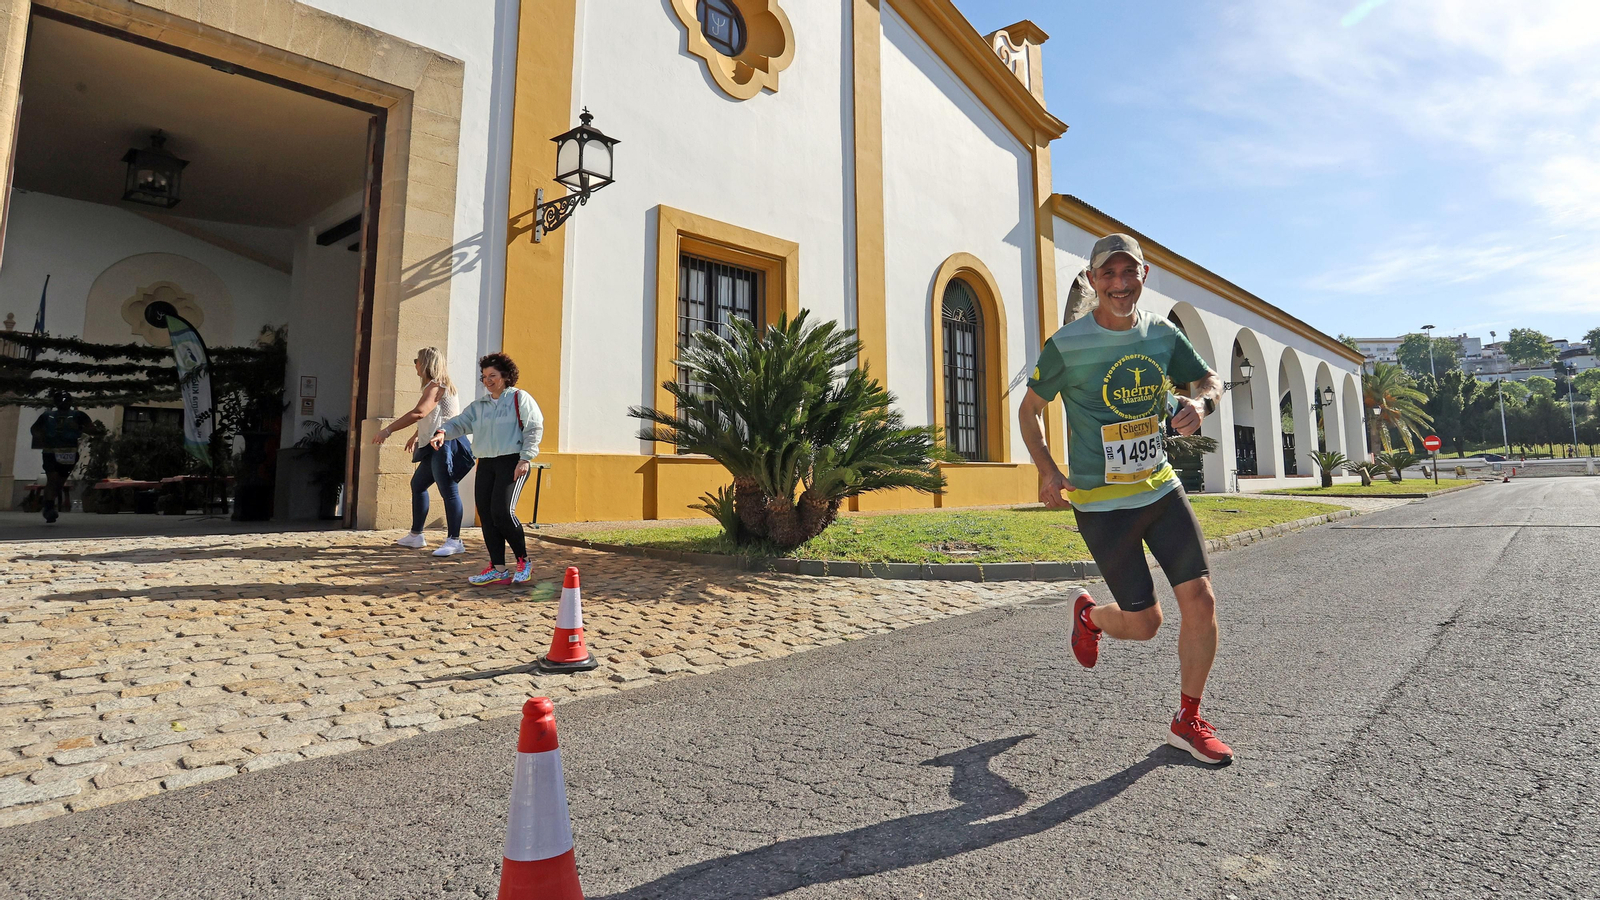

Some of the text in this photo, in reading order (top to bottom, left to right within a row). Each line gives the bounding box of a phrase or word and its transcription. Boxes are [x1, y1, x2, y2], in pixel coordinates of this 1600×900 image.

[1113, 385, 1159, 400] Sherry
[1122, 421, 1150, 434] Sherry
[1117, 437, 1157, 465] 1495
